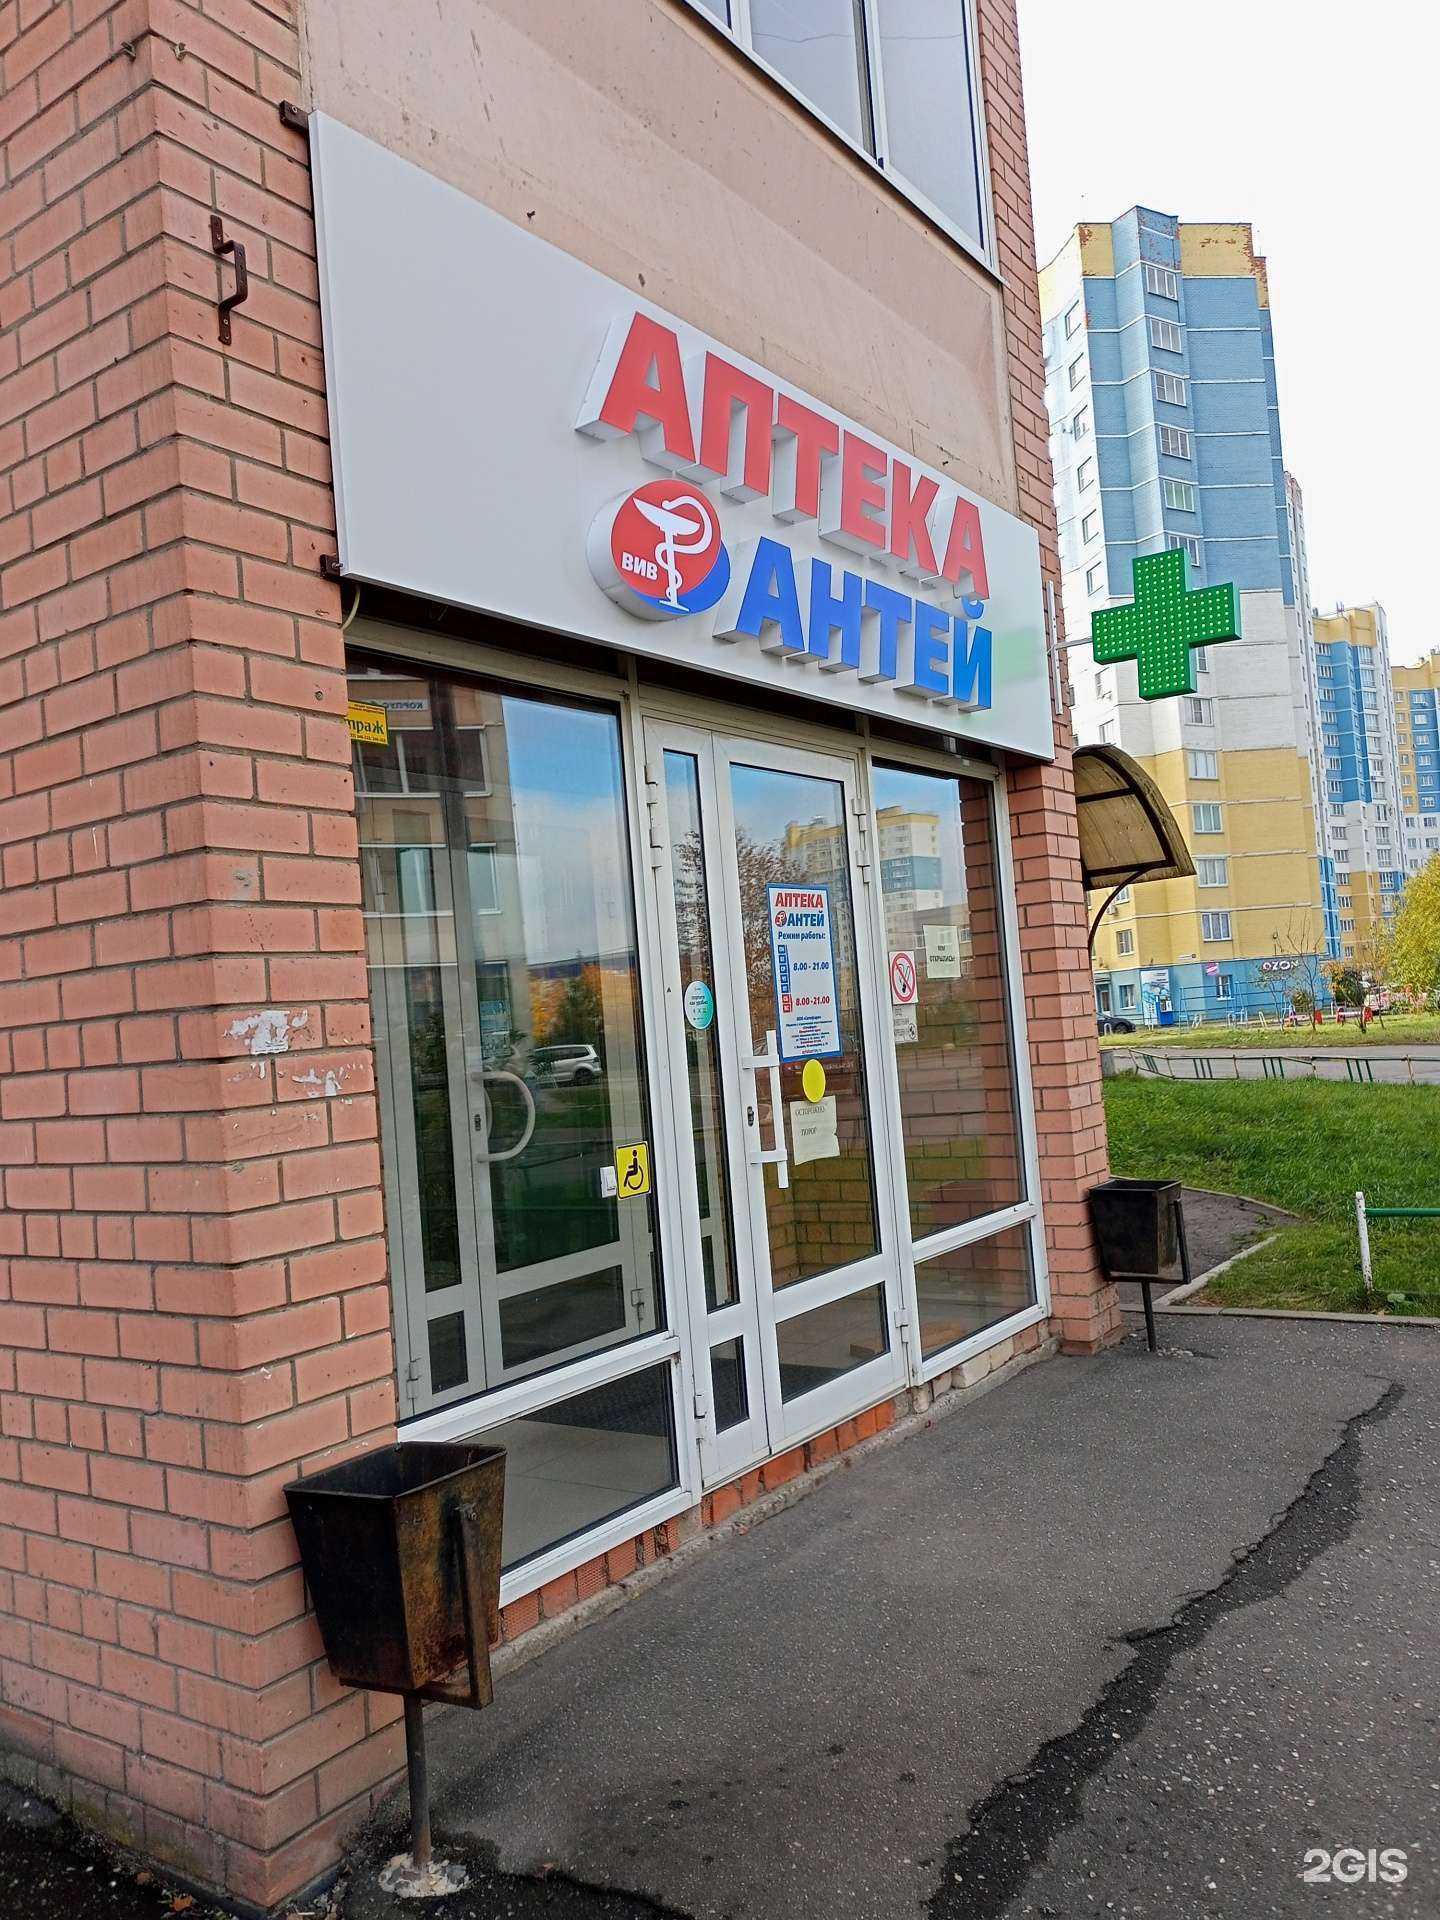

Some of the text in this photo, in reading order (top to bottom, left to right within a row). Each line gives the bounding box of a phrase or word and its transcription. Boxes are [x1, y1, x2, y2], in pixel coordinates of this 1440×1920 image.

[597, 311, 991, 600] АПТЕКА
[620, 551, 659, 581] ВИВ
[734, 535, 993, 710] АНТЕЙ
[775, 892, 824, 908] АПТЕКА
[786, 910, 825, 927] АНТЕЙ
[778, 930, 826, 942] Режим работы:
[1262, 959, 1299, 971] OZON
